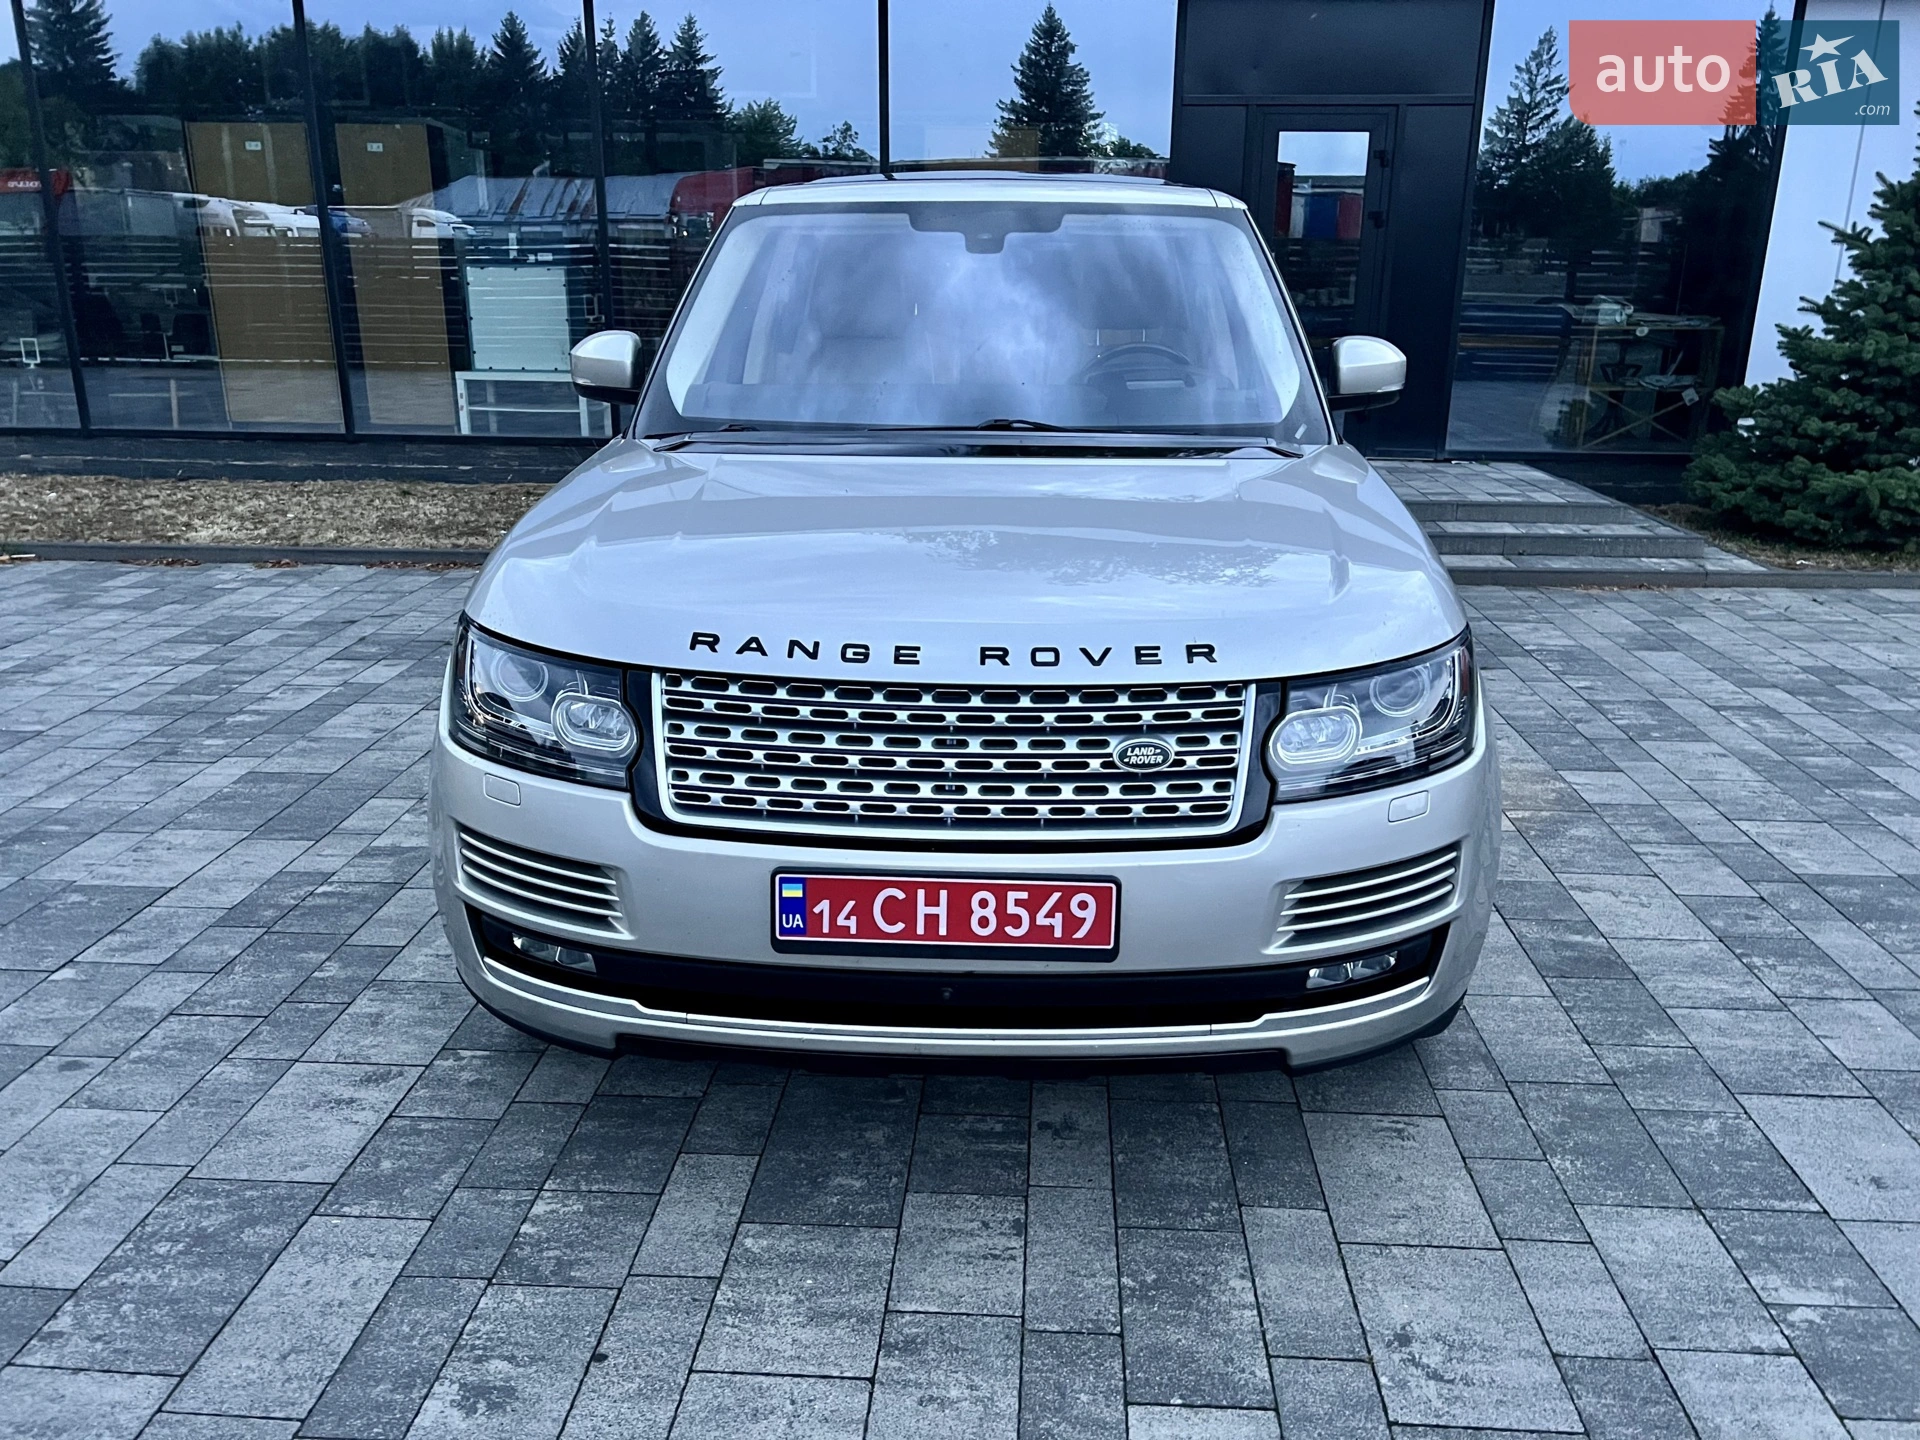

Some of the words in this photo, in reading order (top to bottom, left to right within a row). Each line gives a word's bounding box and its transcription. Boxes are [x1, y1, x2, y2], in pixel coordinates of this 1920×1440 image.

[689, 631, 921, 665] RANGE
[979, 643, 1218, 667] ROVER
[1127, 747, 1154, 756] LAND
[1129, 756, 1163, 764] ROVER
[812, 899, 857, 935] 14
[872, 887, 948, 936] CH
[970, 890, 1097, 939] 8549
[782, 914, 803, 928] UA
